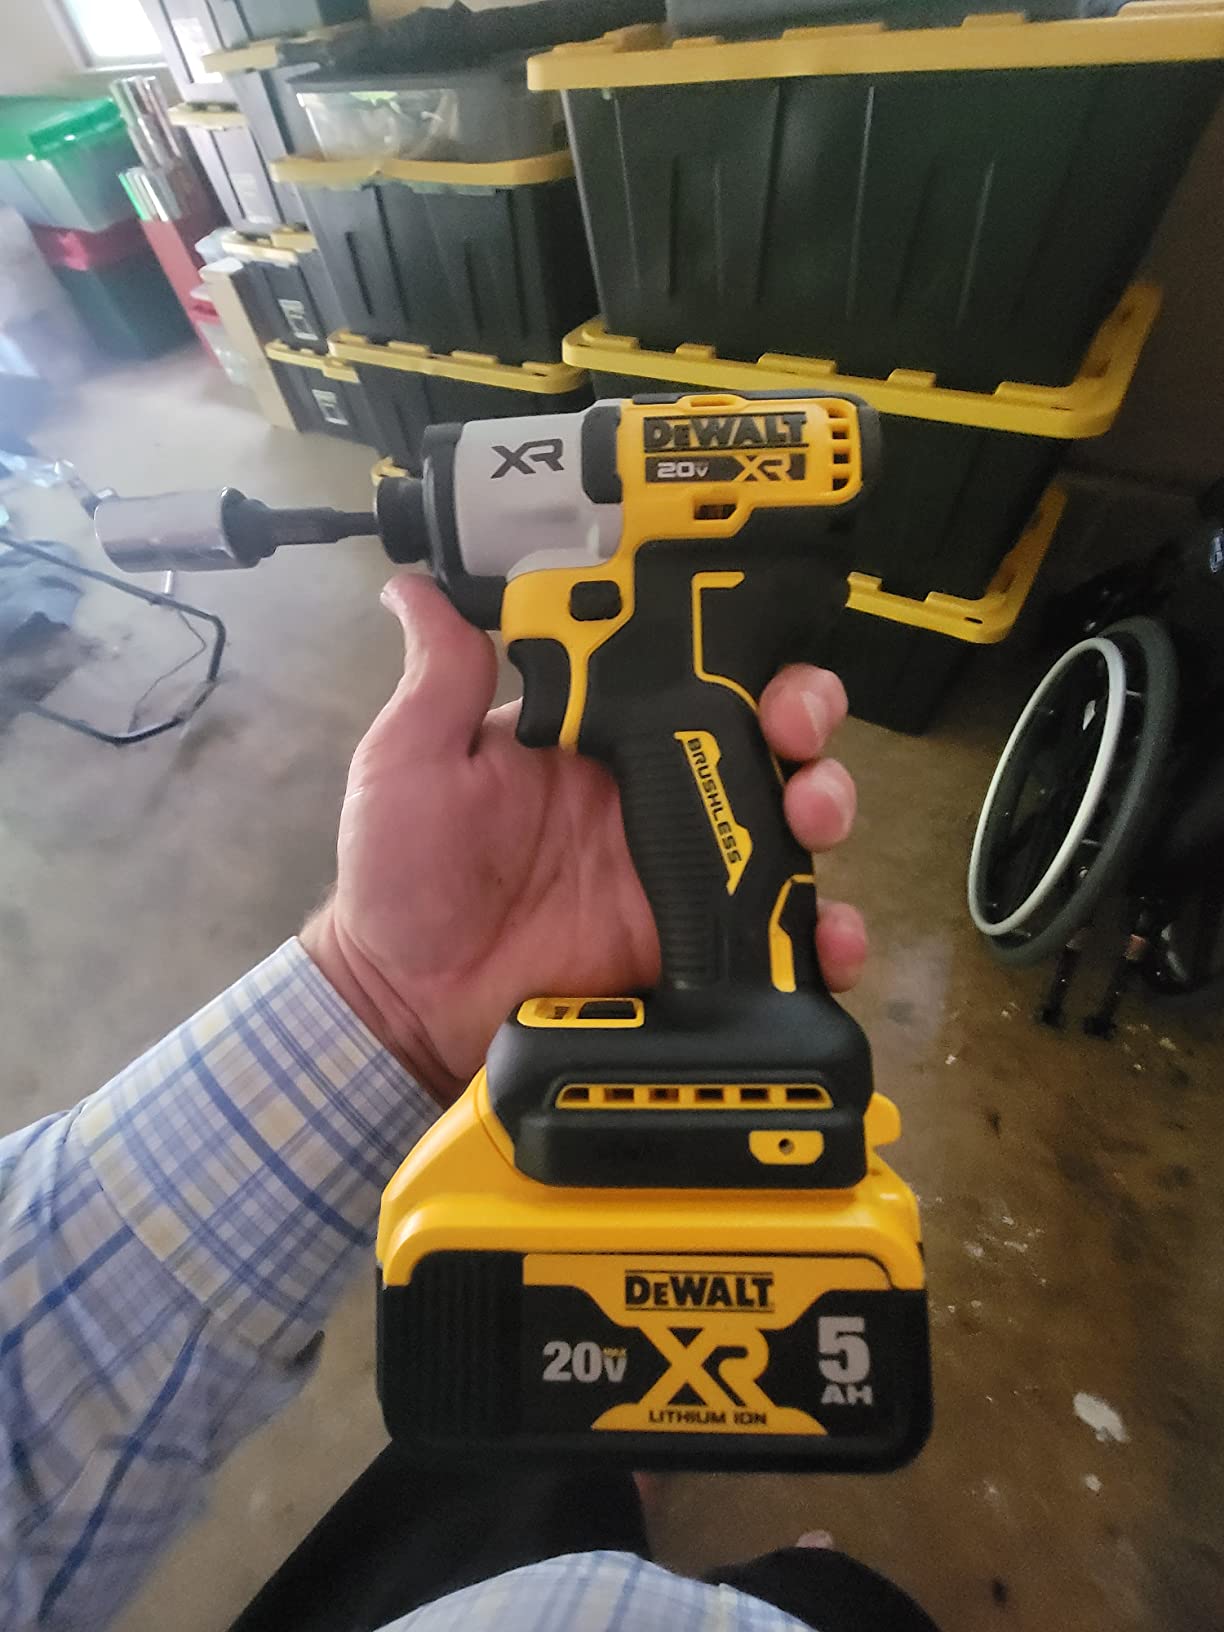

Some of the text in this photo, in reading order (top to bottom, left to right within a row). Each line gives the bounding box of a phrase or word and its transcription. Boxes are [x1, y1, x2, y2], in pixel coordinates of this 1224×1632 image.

[491, 439, 564, 479] XR
[731, 454, 793, 482] XR
[688, 738, 742, 864] BRUSHLESS
[638, 1325, 777, 1406] XR
[818, 1316, 871, 1384] 5
[649, 1409, 767, 1425] LITHIUM ION
